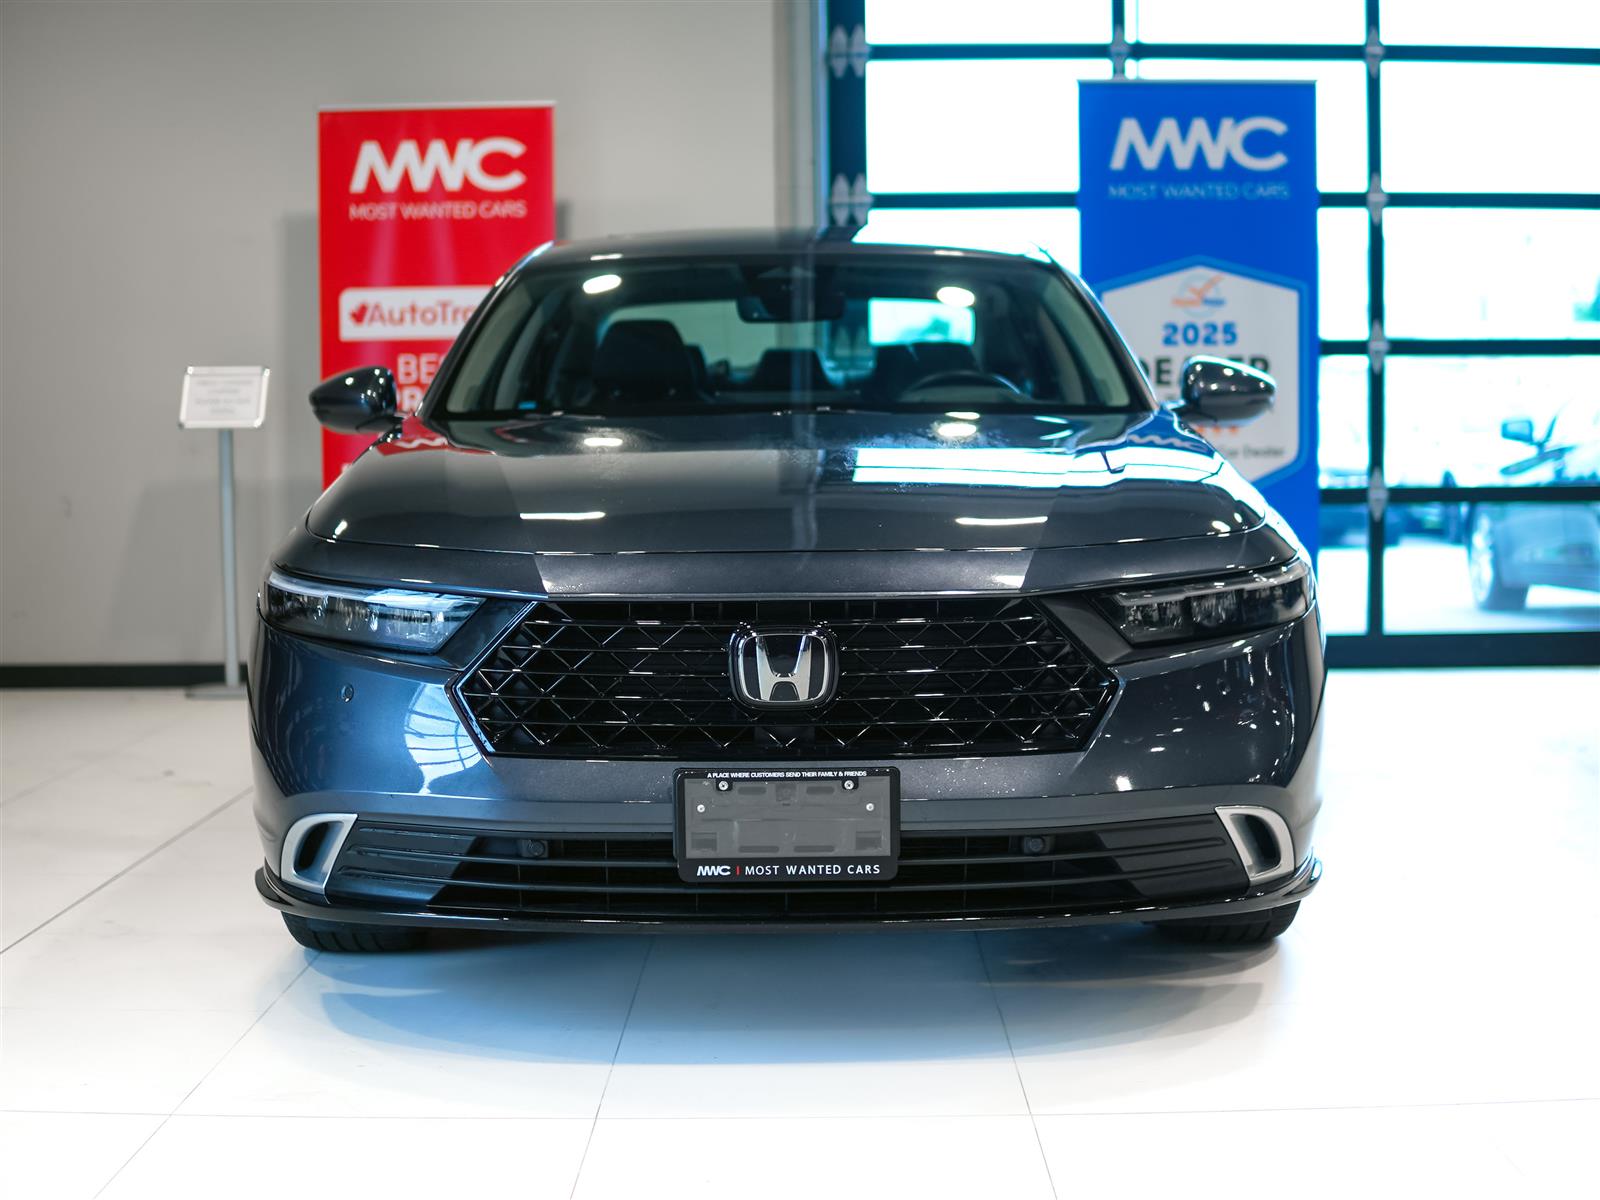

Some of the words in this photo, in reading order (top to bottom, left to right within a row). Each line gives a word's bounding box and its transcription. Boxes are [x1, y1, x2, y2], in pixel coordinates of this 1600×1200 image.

[1109, 117, 1288, 171] MWC
[349, 137, 526, 193] MWC
[1108, 183, 1156, 199] MOST
[1161, 183, 1239, 199] WANTED
[1242, 182, 1289, 199] CARS
[349, 203, 396, 220] MOST
[399, 202, 477, 219] WANTED
[479, 201, 527, 218] CARS
[1162, 322, 1238, 346] 2025
[696, 865, 731, 876] MWC
[745, 865, 779, 875] MOST
[785, 865, 841, 875] WANTED
[847, 864, 880, 874] CARS
